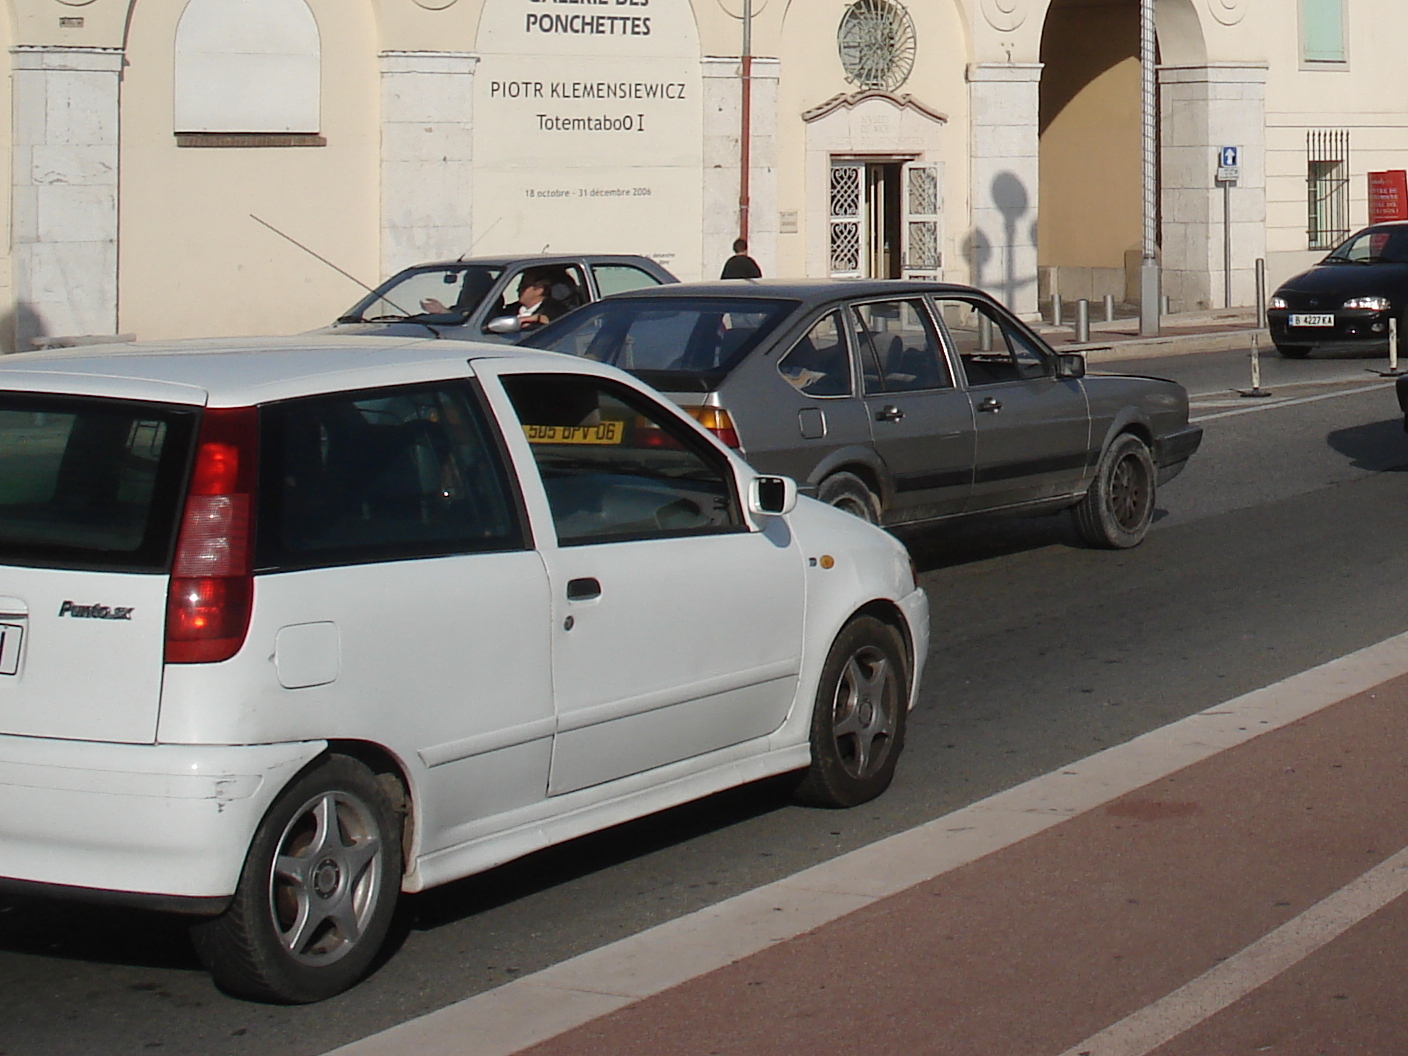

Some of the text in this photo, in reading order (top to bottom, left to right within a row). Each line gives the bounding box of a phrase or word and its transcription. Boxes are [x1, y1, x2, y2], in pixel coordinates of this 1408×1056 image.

[525, 13, 651, 36] PONCHETTES
[490, 81, 687, 100] PIOTR KLEMENSIEWICZ
[525, 189, 535, 198] 18
[537, 189, 570, 198] octobre
[578, 188, 588, 197] 31
[632, 187, 652, 197] 2006
[1303, 315, 1321, 325] 4227
[595, 421, 615, 441] 06
